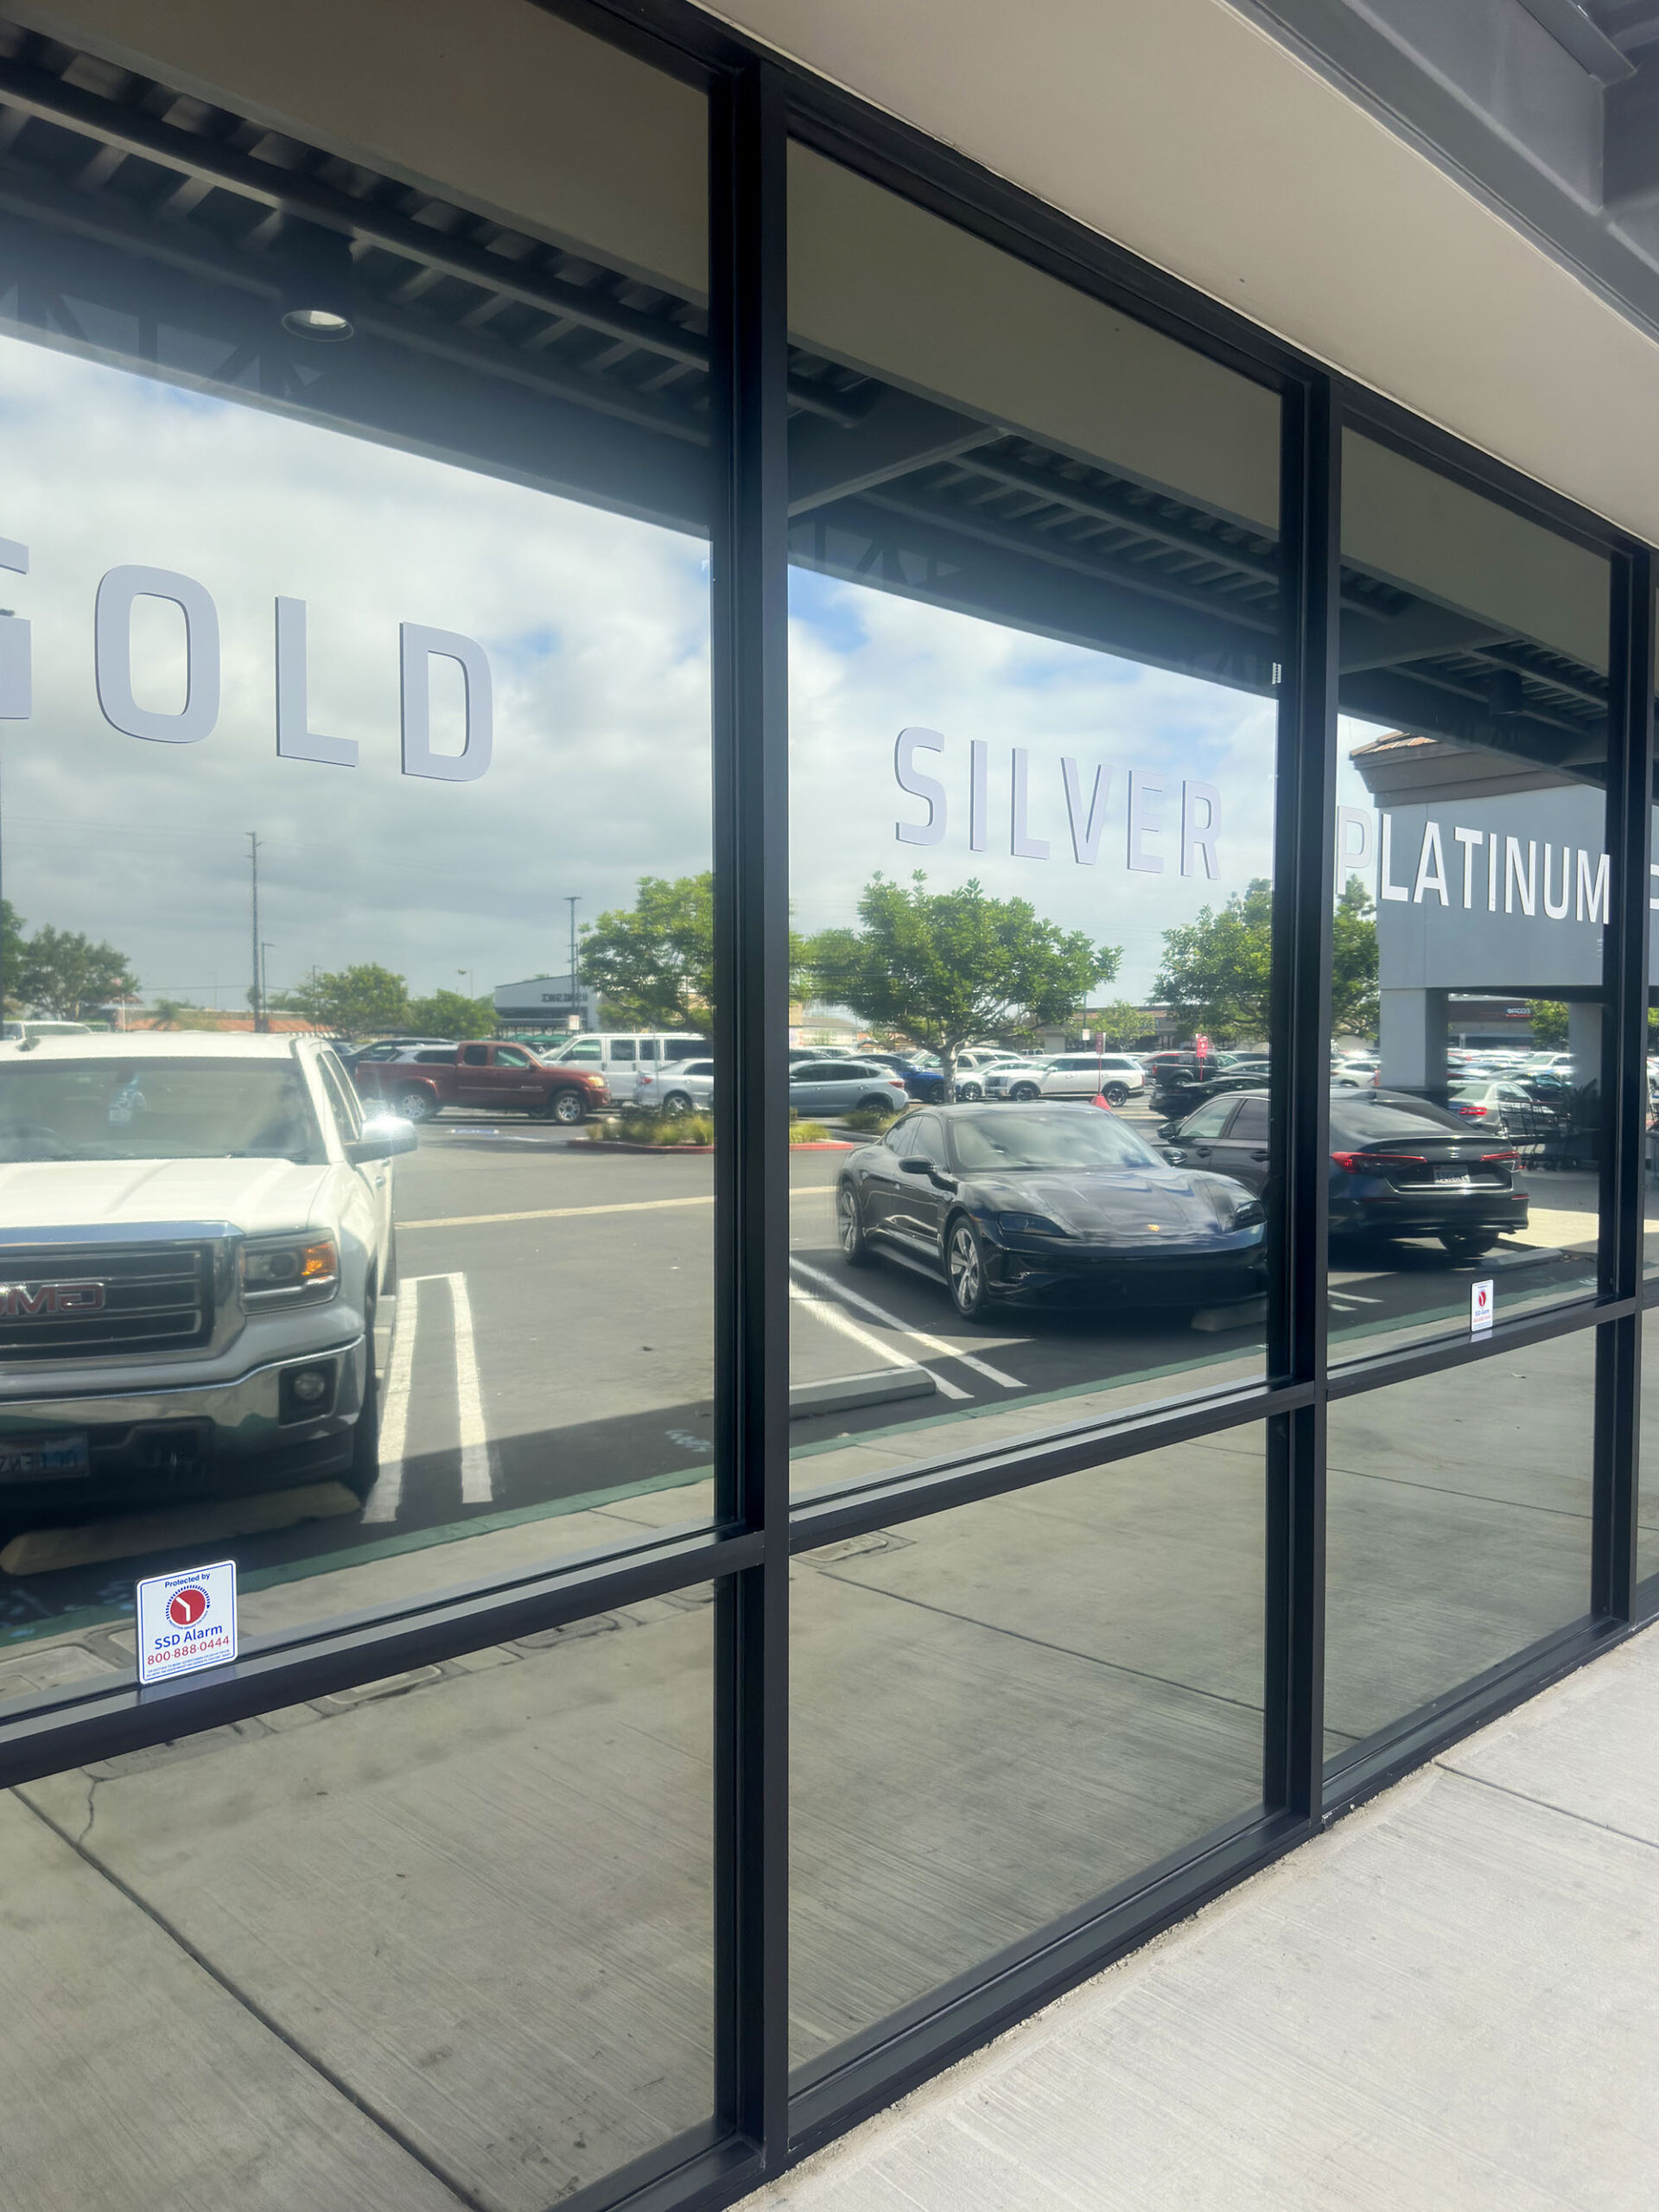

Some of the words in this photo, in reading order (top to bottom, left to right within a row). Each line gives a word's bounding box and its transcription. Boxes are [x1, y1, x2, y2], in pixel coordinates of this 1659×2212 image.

[0, 537, 493, 782] OLD
[894, 726, 1223, 880] SILVER
[1336, 805, 1611, 925] PLATINUM
[154, 1634, 181, 1649] SSD
[183, 1624, 223, 1643] Alarm
[164, 1575, 200, 1588] Protected
